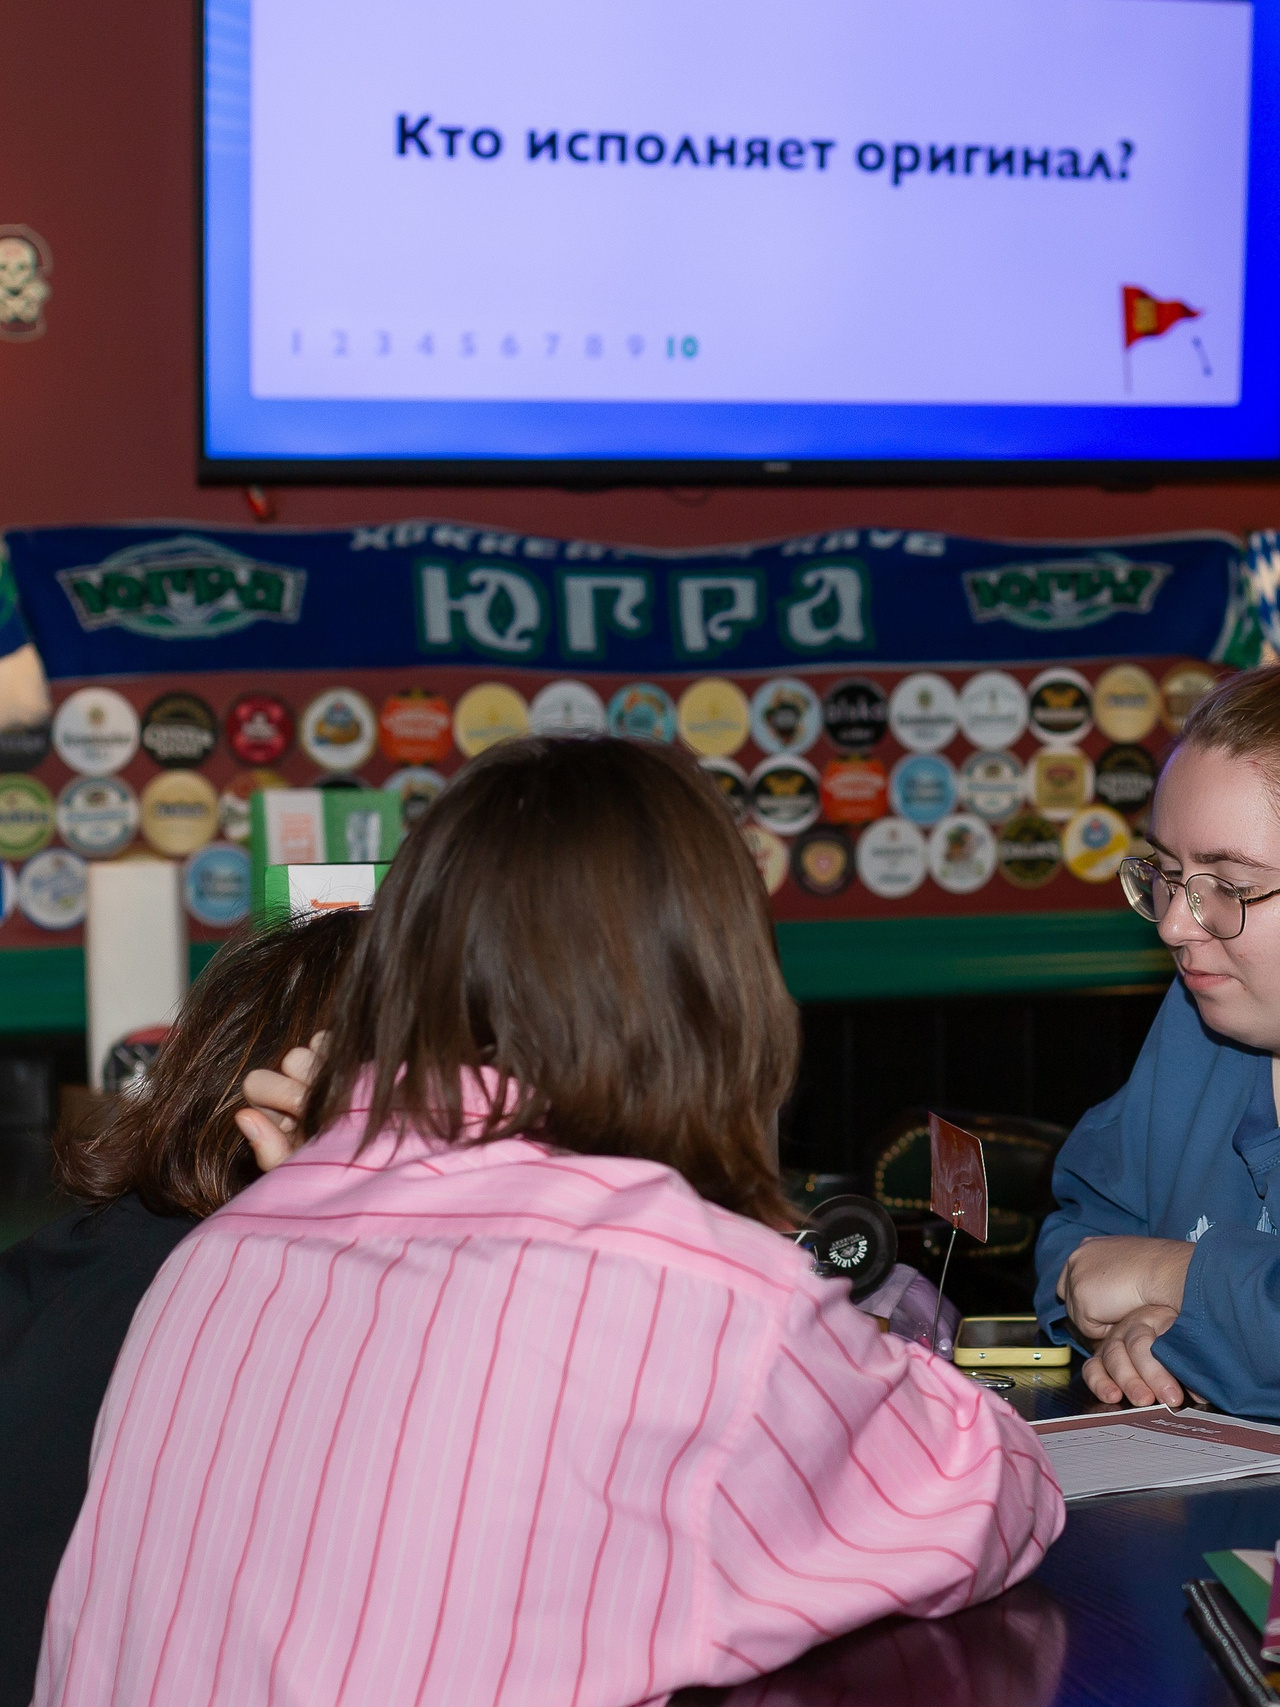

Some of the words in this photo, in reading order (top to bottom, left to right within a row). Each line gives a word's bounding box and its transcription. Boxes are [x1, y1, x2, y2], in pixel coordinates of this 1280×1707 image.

[396, 113, 502, 160] Кто
[527, 129, 836, 171] исполняет
[856, 138, 1135, 188] оригинал?
[332, 330, 348, 356] 2
[376, 330, 392, 357] 3
[417, 332, 435, 357] 4
[460, 331, 476, 358] 5
[501, 333, 519, 358] 6
[545, 332, 561, 358] 7
[585, 333, 601, 358] 8
[626, 333, 645, 358] 9
[665, 335, 699, 359] 10
[828, 1250, 852, 1268] IRISH
[852, 1239, 868, 1266] BORN
